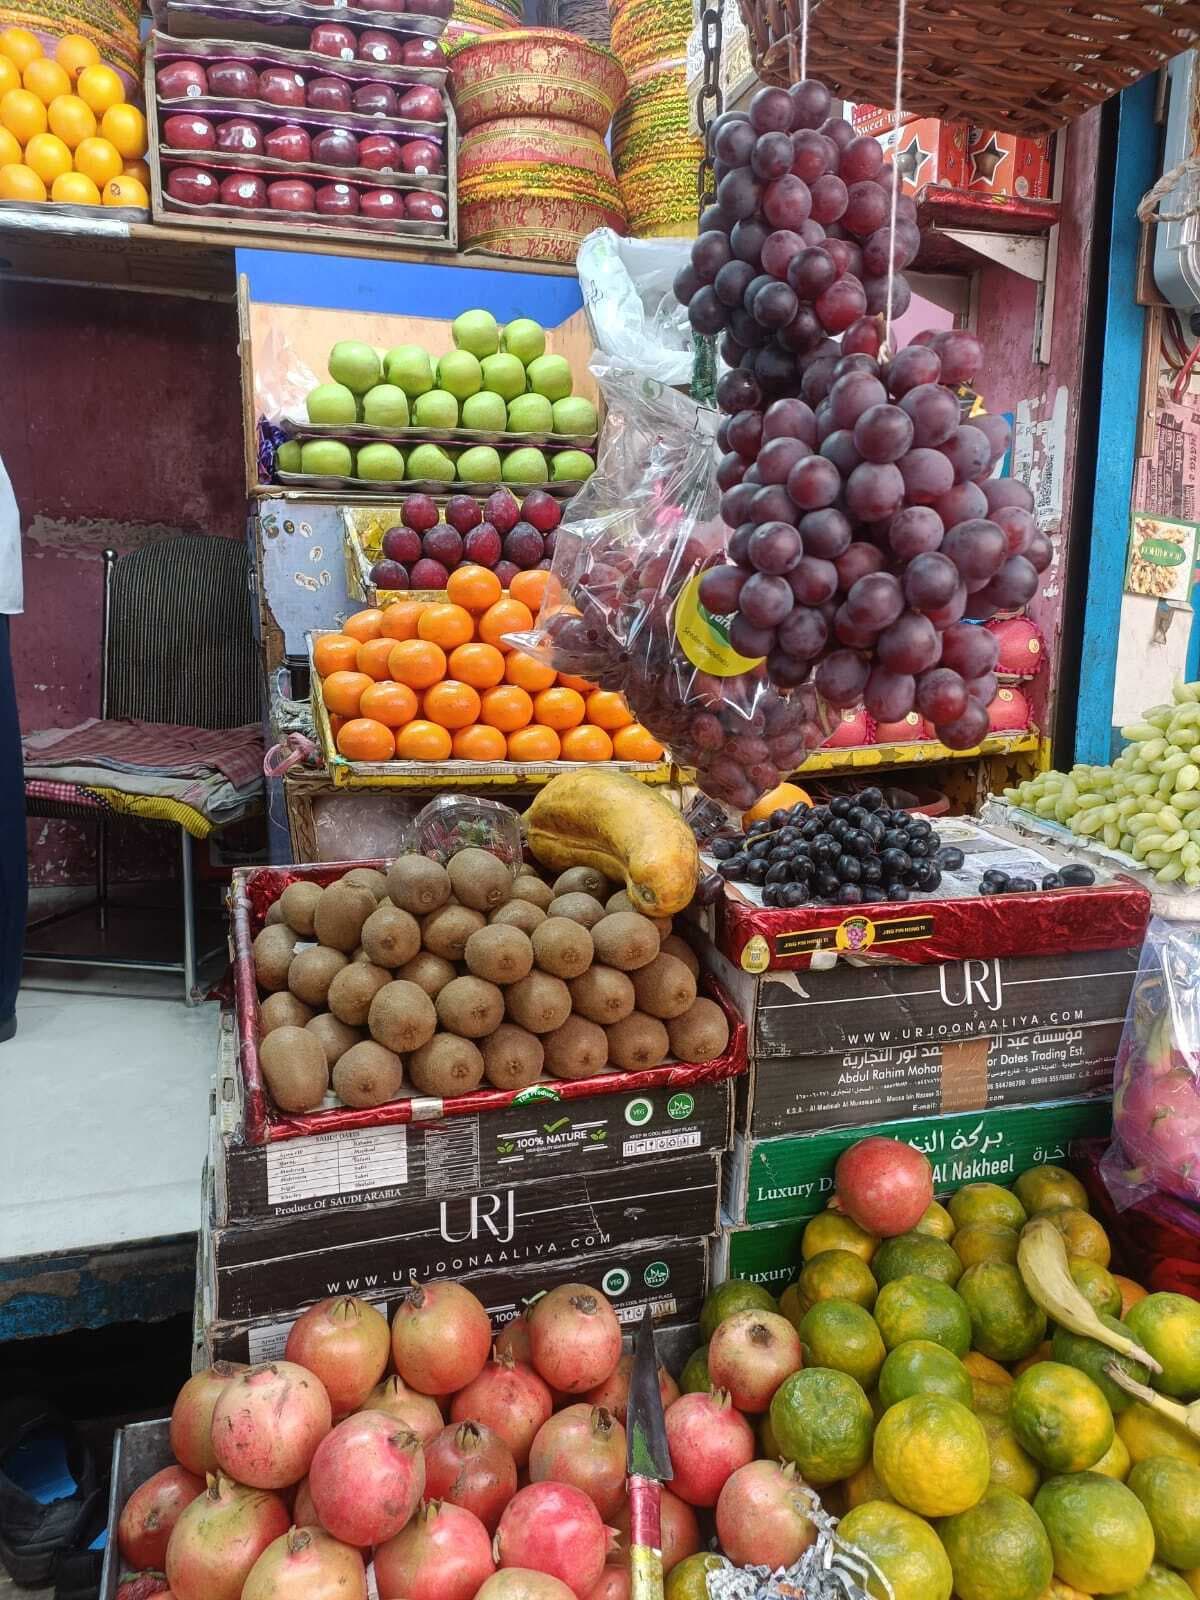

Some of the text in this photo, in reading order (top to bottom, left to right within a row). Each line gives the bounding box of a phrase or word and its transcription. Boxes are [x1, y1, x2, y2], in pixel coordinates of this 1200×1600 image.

[939, 958, 1004, 1011] URJ
[847, 1010, 1085, 1045] WWW.URJOONAALIYA.COM
[1032, 1028, 1083, 1045] مؤسسة
[1006, 1035, 1030, 1050] عبد
[838, 1069, 870, 1085] Abdul
[872, 1066, 905, 1081] Rahim
[1000, 1052, 1029, 1065] Dates
[1030, 1048, 1067, 1061] Trading
[1069, 1045, 1086, 1057] Est.
[895, 1045, 918, 1065] نور
[516, 1129, 588, 1149] 100% NATURE
[895, 1119, 1004, 1154] بركة النخ
[1032, 1143, 1071, 1164] اخرة
[931, 1153, 1015, 1184] Al Nakheel
[275, 1203, 312, 1216] Product
[330, 1193, 362, 1207] SAUDI
[363, 1188, 401, 1202] ARABIA
[757, 1181, 814, 1202] Luxury
[439, 1190, 515, 1243] URJ
[326, 1233, 611, 1294] WWW.URJOONAALIYA.COM
[739, 1264, 796, 1285] Luxury
[495, 1310, 521, 1323] 100%
